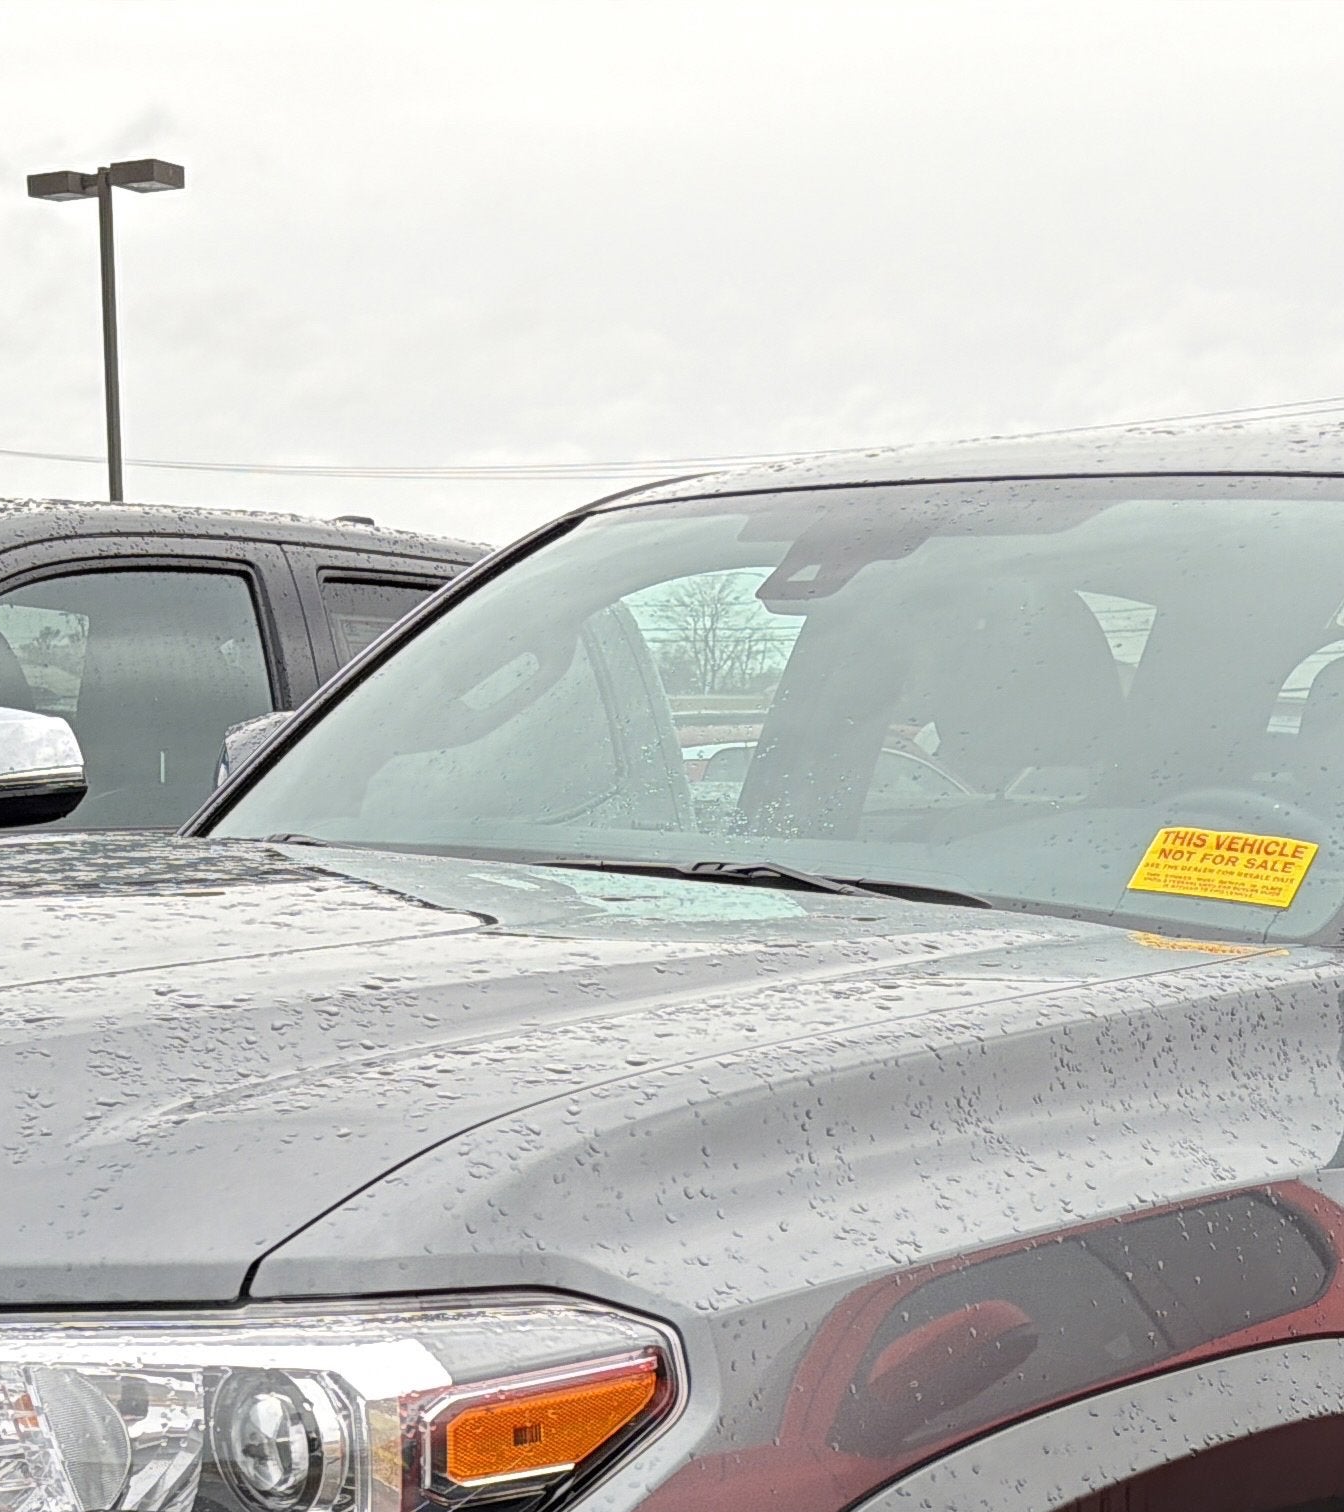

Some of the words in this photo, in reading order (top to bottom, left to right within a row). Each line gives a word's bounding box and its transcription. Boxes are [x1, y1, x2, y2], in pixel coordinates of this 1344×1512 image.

[1162, 831, 1208, 848] THIS
[1214, 834, 1308, 860] VEHICLE
[1157, 848, 1198, 862] NOT
[1199, 853, 1238, 867] FOR
[1243, 858, 1296, 874] SALE
